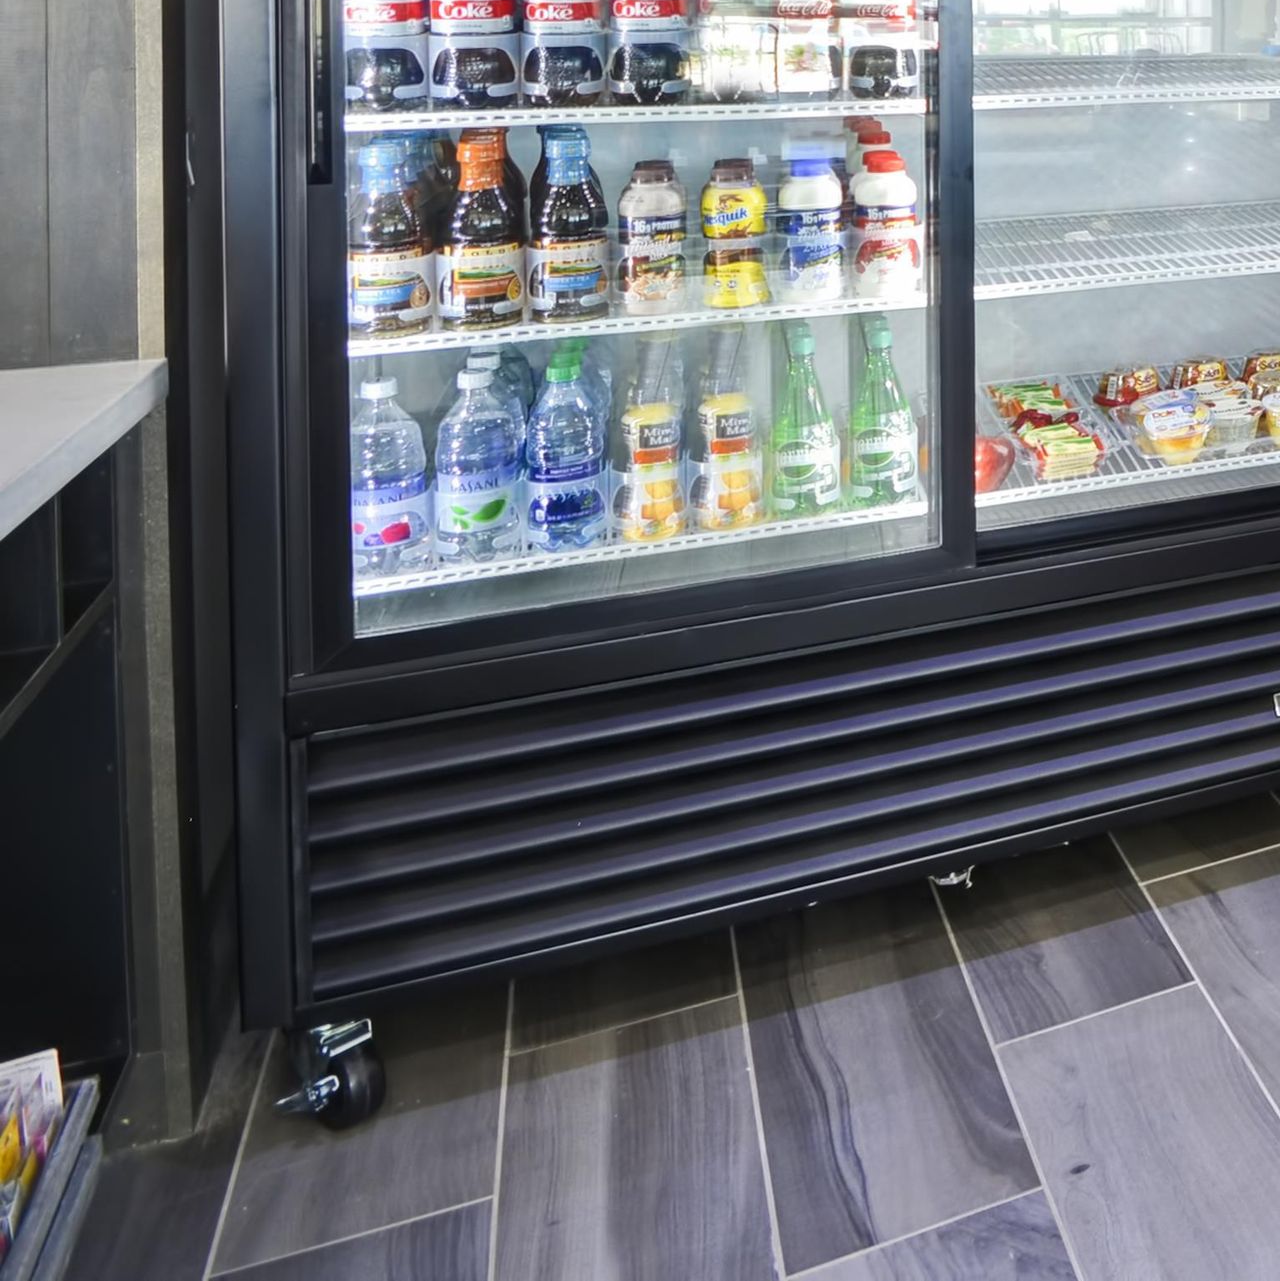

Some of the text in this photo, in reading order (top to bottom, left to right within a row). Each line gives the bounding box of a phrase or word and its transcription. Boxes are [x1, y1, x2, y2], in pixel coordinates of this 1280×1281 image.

[438, 1, 494, 19] Coke
[525, 3, 575, 20] Coke
[612, 0, 661, 19] Coke
[353, 493, 404, 508] DAANI
